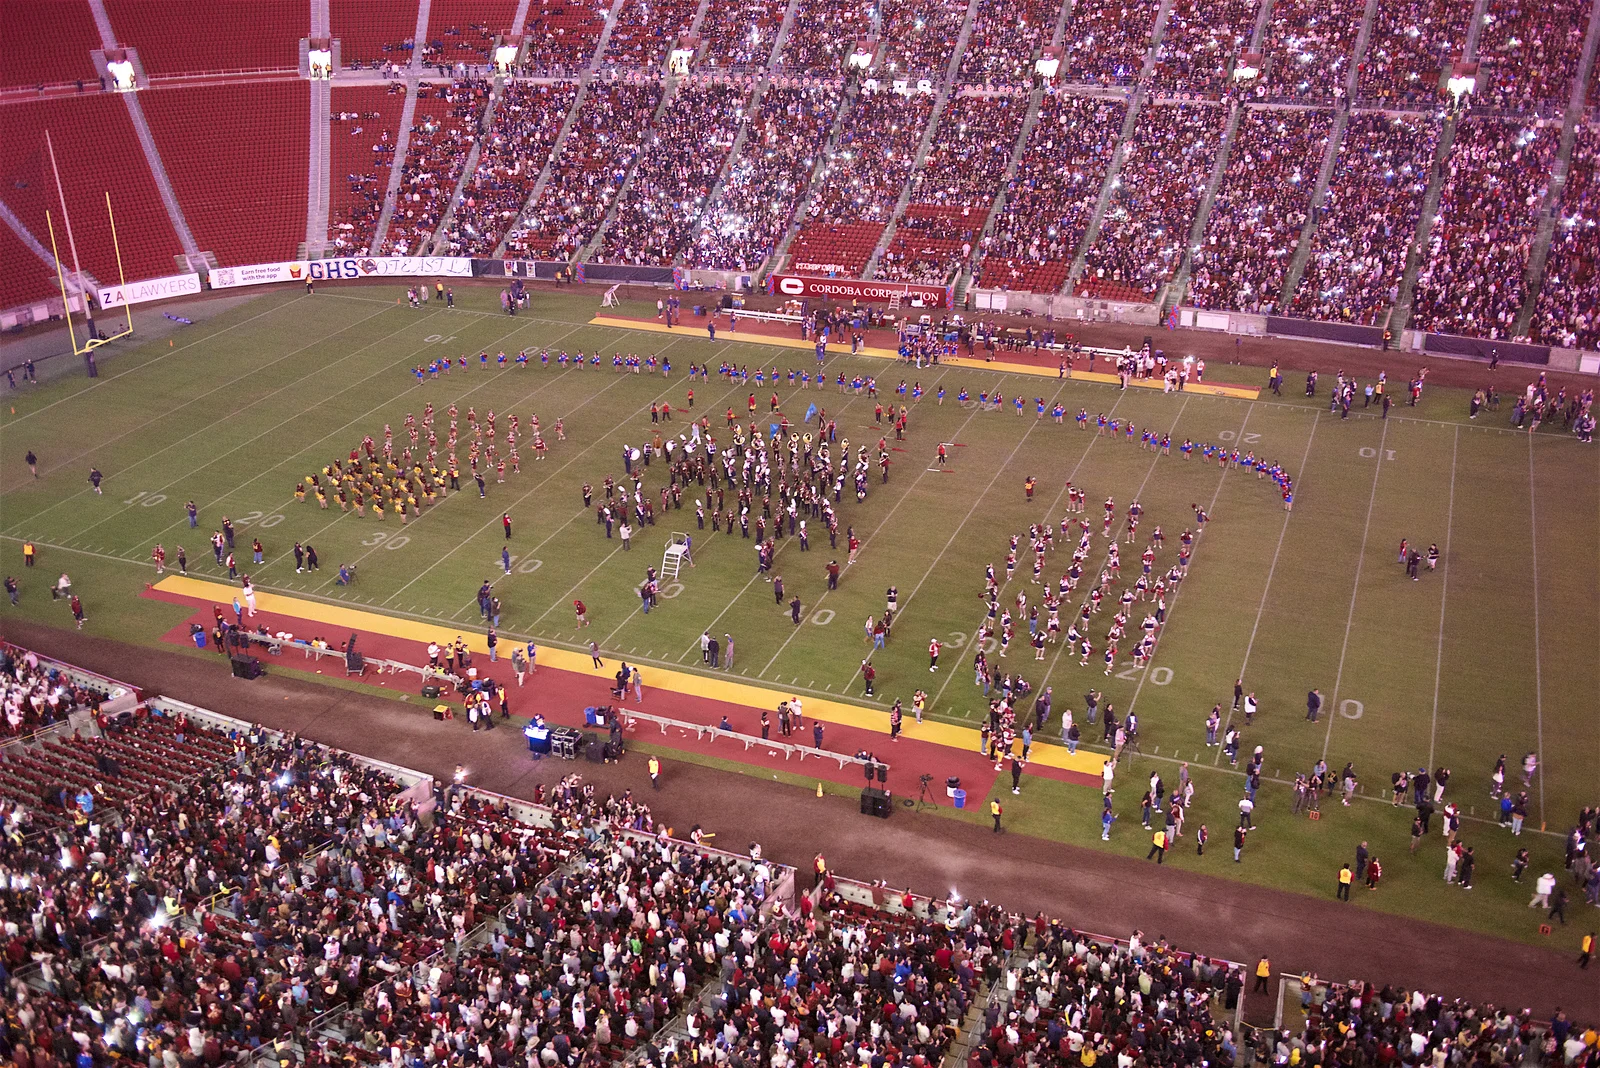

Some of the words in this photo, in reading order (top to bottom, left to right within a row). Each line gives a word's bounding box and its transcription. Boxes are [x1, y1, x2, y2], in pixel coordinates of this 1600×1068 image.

[310, 260, 358, 279] GHS
[131, 277, 197, 300] LAWYERS
[809, 283, 861, 296] CORDOBA
[1218, 430, 1262, 444] 20
[1358, 446, 1397, 461] 10
[123, 491, 168, 507] 10
[235, 511, 286, 528] 20
[361, 532, 411, 550] 30
